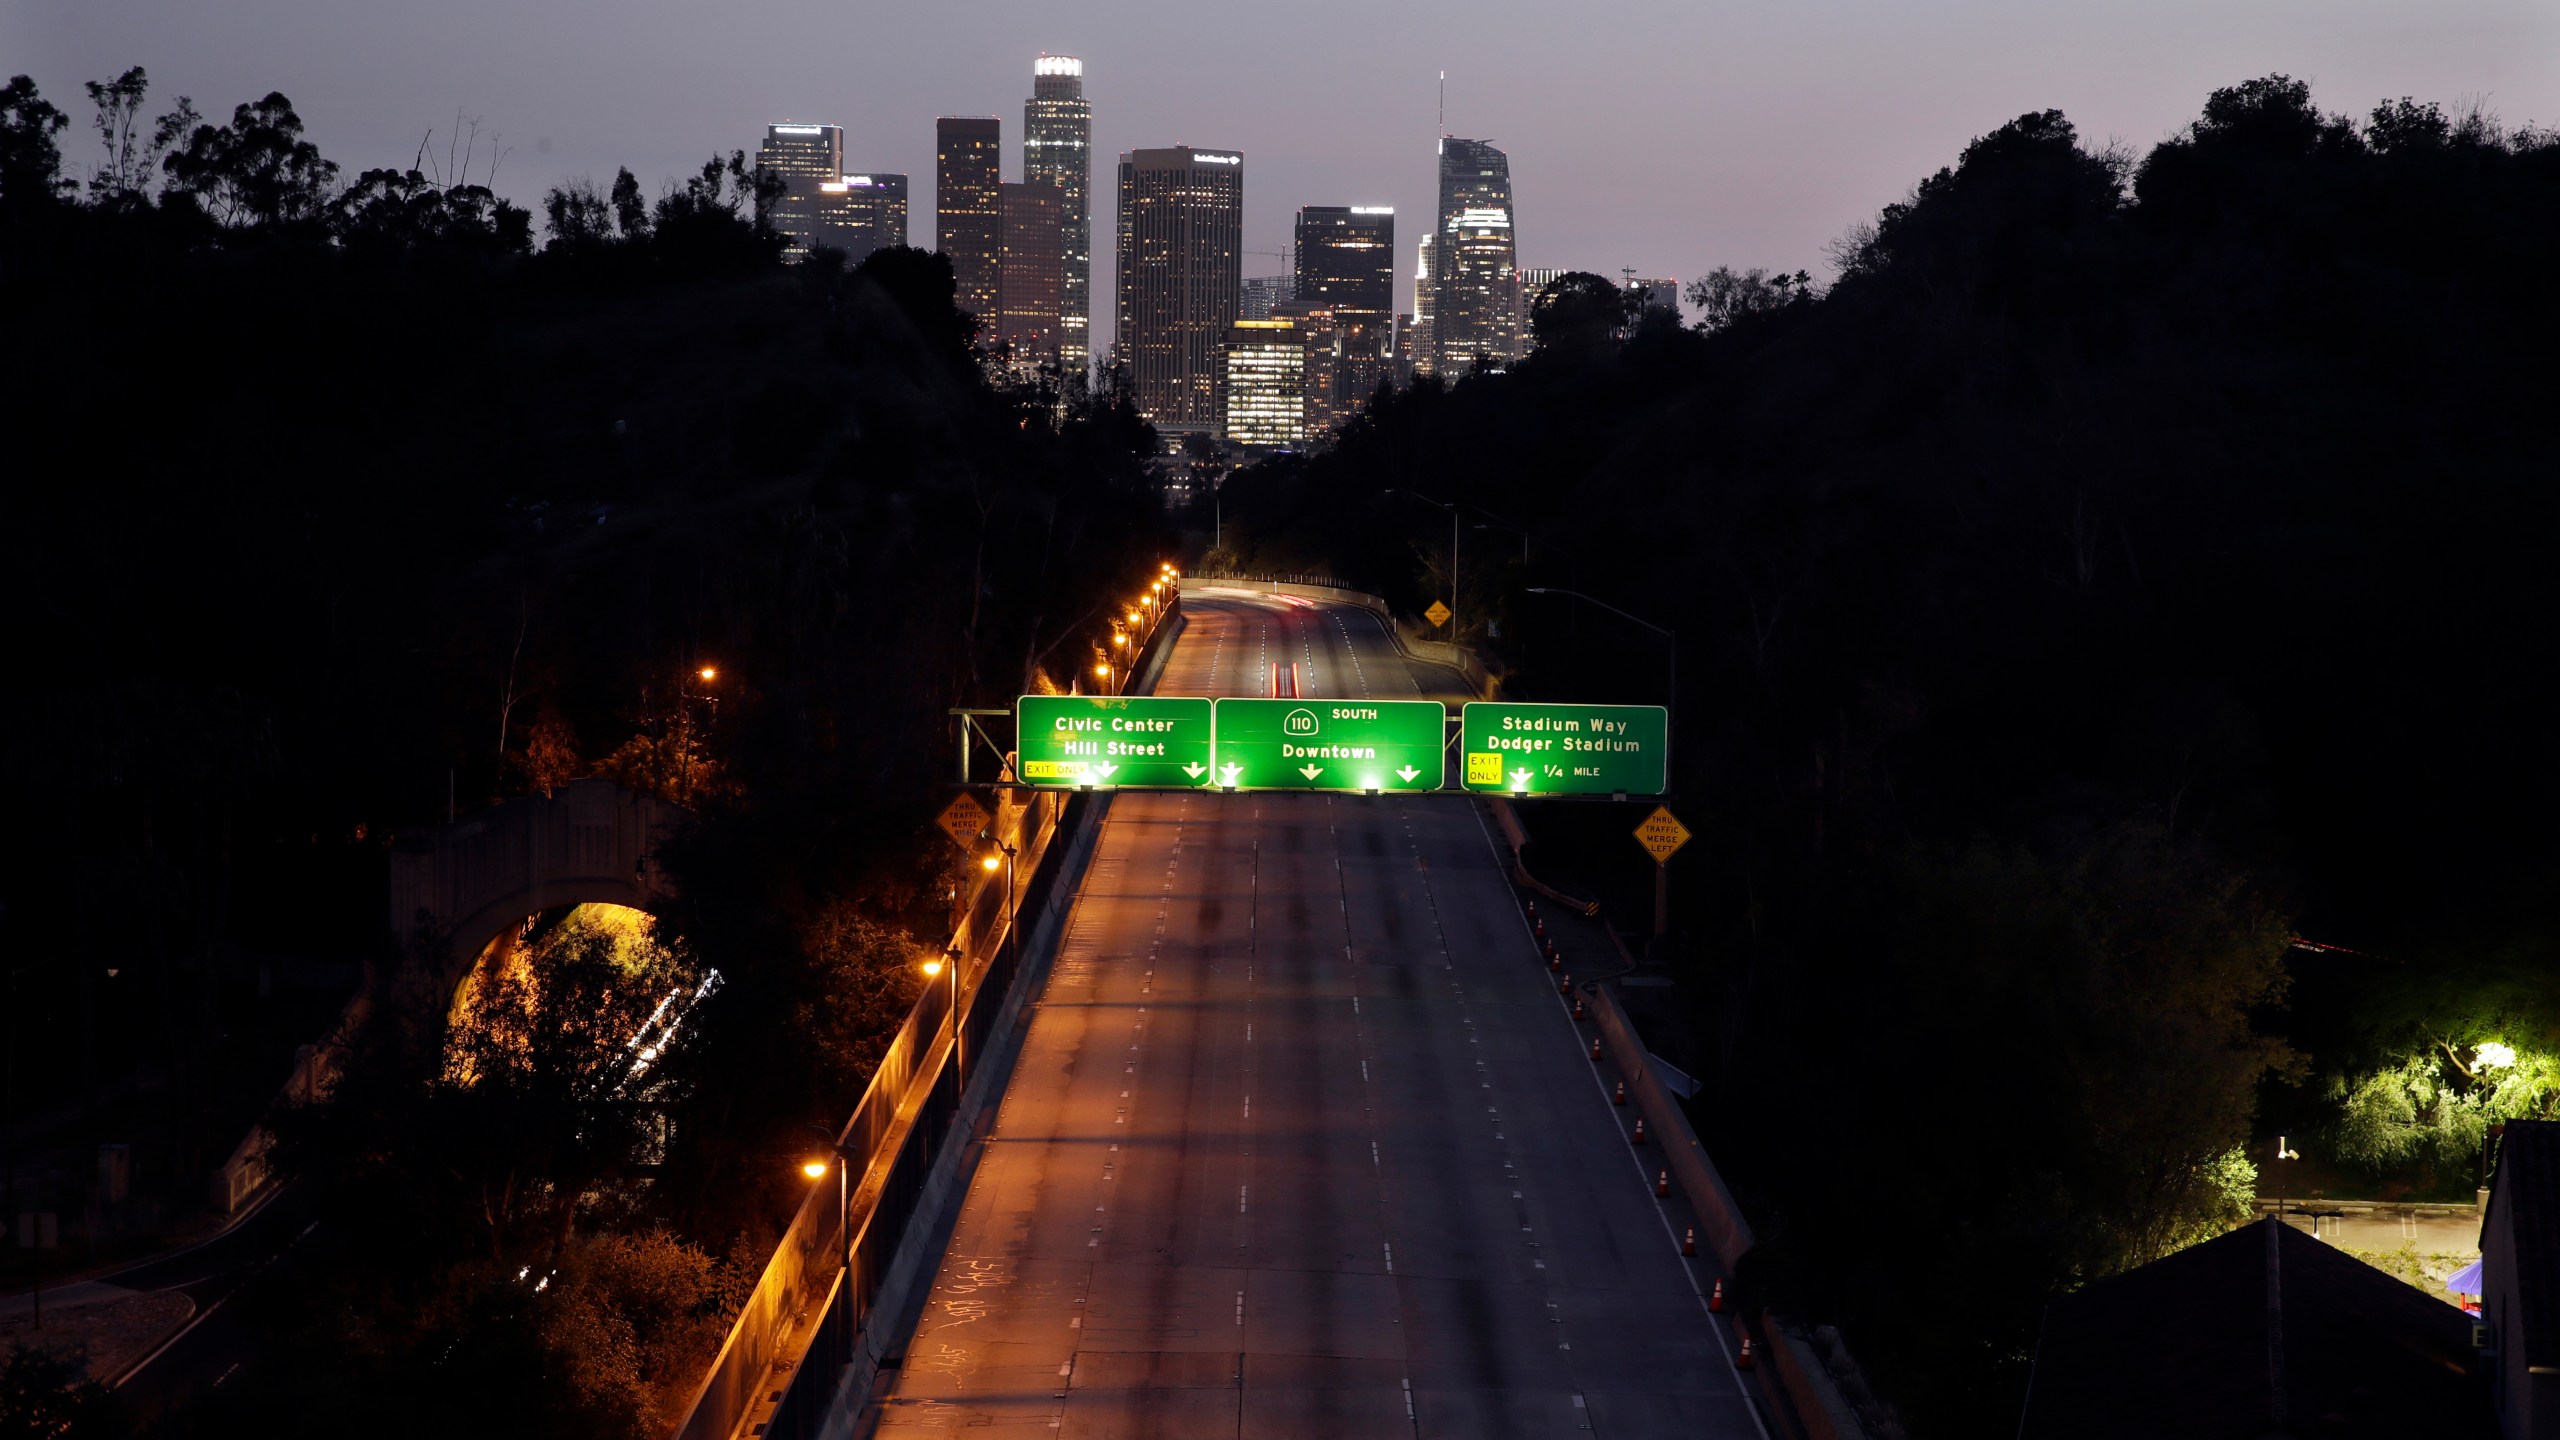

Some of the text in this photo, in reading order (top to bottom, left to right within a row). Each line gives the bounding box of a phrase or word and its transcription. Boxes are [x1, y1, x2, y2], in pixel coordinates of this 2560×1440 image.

[1332, 708, 1377, 720] SOUTH
[1055, 717, 1174, 732] Civic Center
[1291, 717, 1311, 730] 110
[1502, 716, 1627, 735] Stadium Way
[1064, 741, 1164, 756] Hill Street
[1488, 735, 1640, 754] Dodger Stadium
[1282, 743, 1375, 759] Downtown
[1471, 757, 1499, 765] EXIT
[1026, 765, 1086, 774] EXIT ONLY
[1574, 767, 1600, 777] MILE
[1469, 771, 1499, 780] ONLY
[949, 811, 981, 819] TRAFFIC
[951, 820, 977, 828] MERGE
[1652, 816, 1673, 824] THRU
[1646, 825, 1679, 834] TRAFFIC
[1646, 835, 1678, 844] MERGE
[1651, 845, 1673, 853] LEFT
